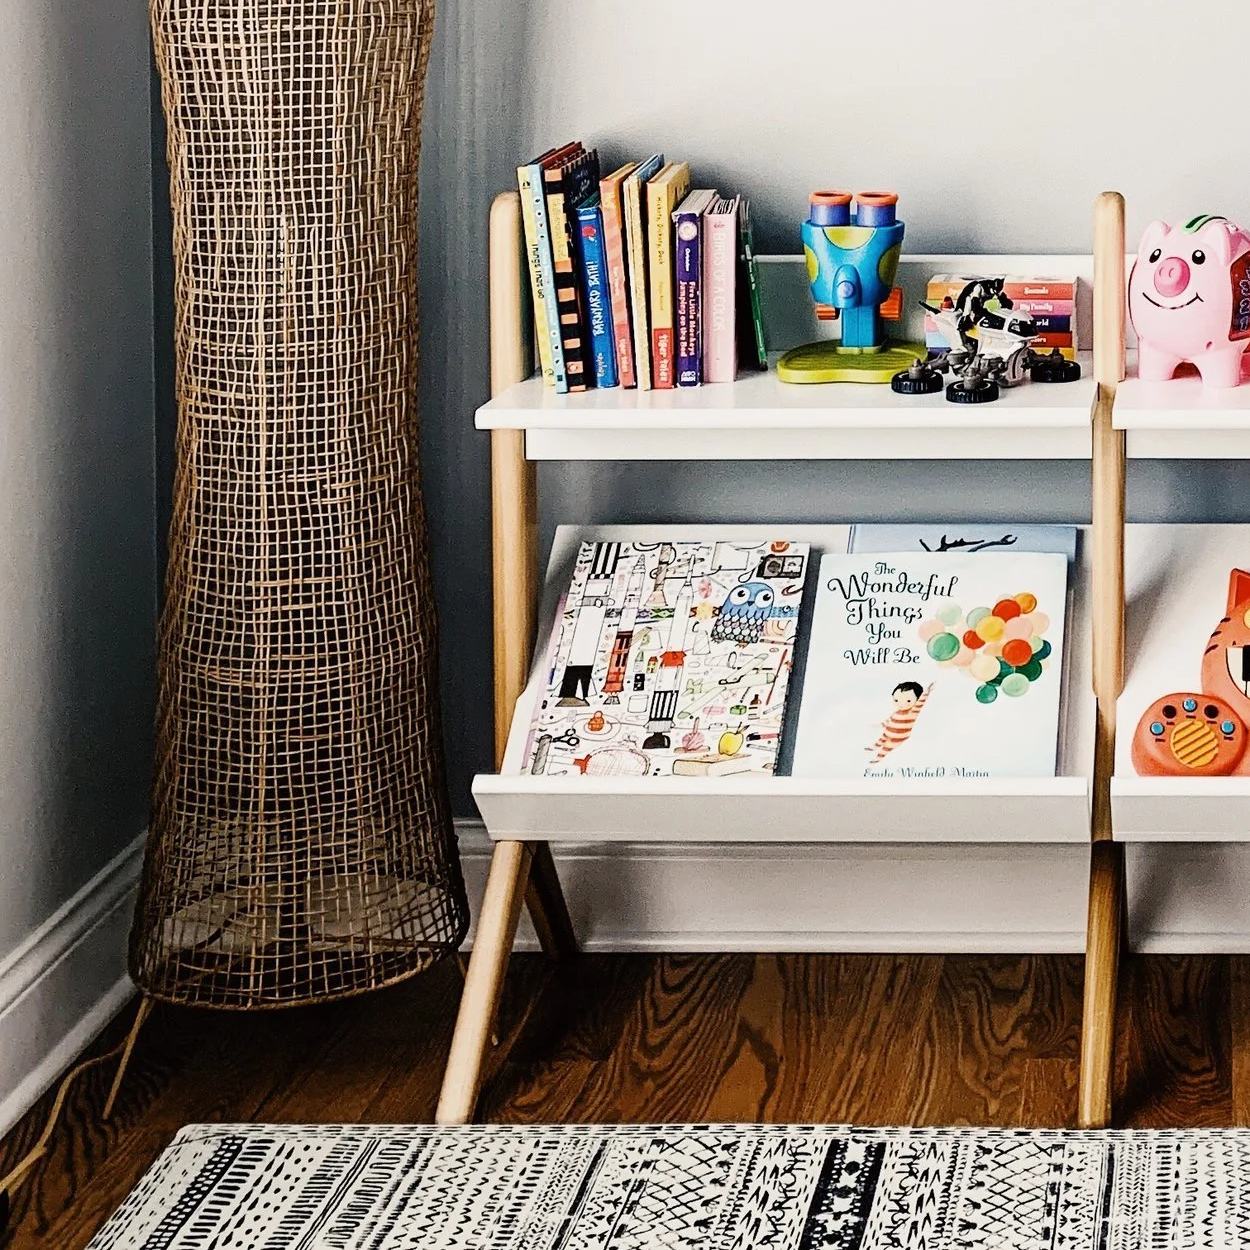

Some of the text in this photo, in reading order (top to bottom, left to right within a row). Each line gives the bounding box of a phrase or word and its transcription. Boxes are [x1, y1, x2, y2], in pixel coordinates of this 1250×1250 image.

[712, 231, 726, 266] BIRDS
[712, 268, 726, 283] OF
[585, 261, 605, 336] BARNYARD BATH!
[712, 285, 726, 293] A
[1023, 286, 1049, 295] Sounds
[678, 281, 688, 357] Jumping on the Bed
[688, 299, 696, 319] Little
[712, 296, 726, 331] COLOR
[1019, 302, 1053, 312] My Family
[688, 320, 697, 357] Monkeys
[618, 338, 629, 373] tiger tales
[658, 333, 668, 382] tiger tales
[875, 562, 896, 575] The
[827, 571, 959, 601] Wonderful
[846, 597, 923, 625] Things
[865, 622, 903, 645] You
[843, 647, 921, 666] Will Be
[950, 766, 989, 778] Martin
